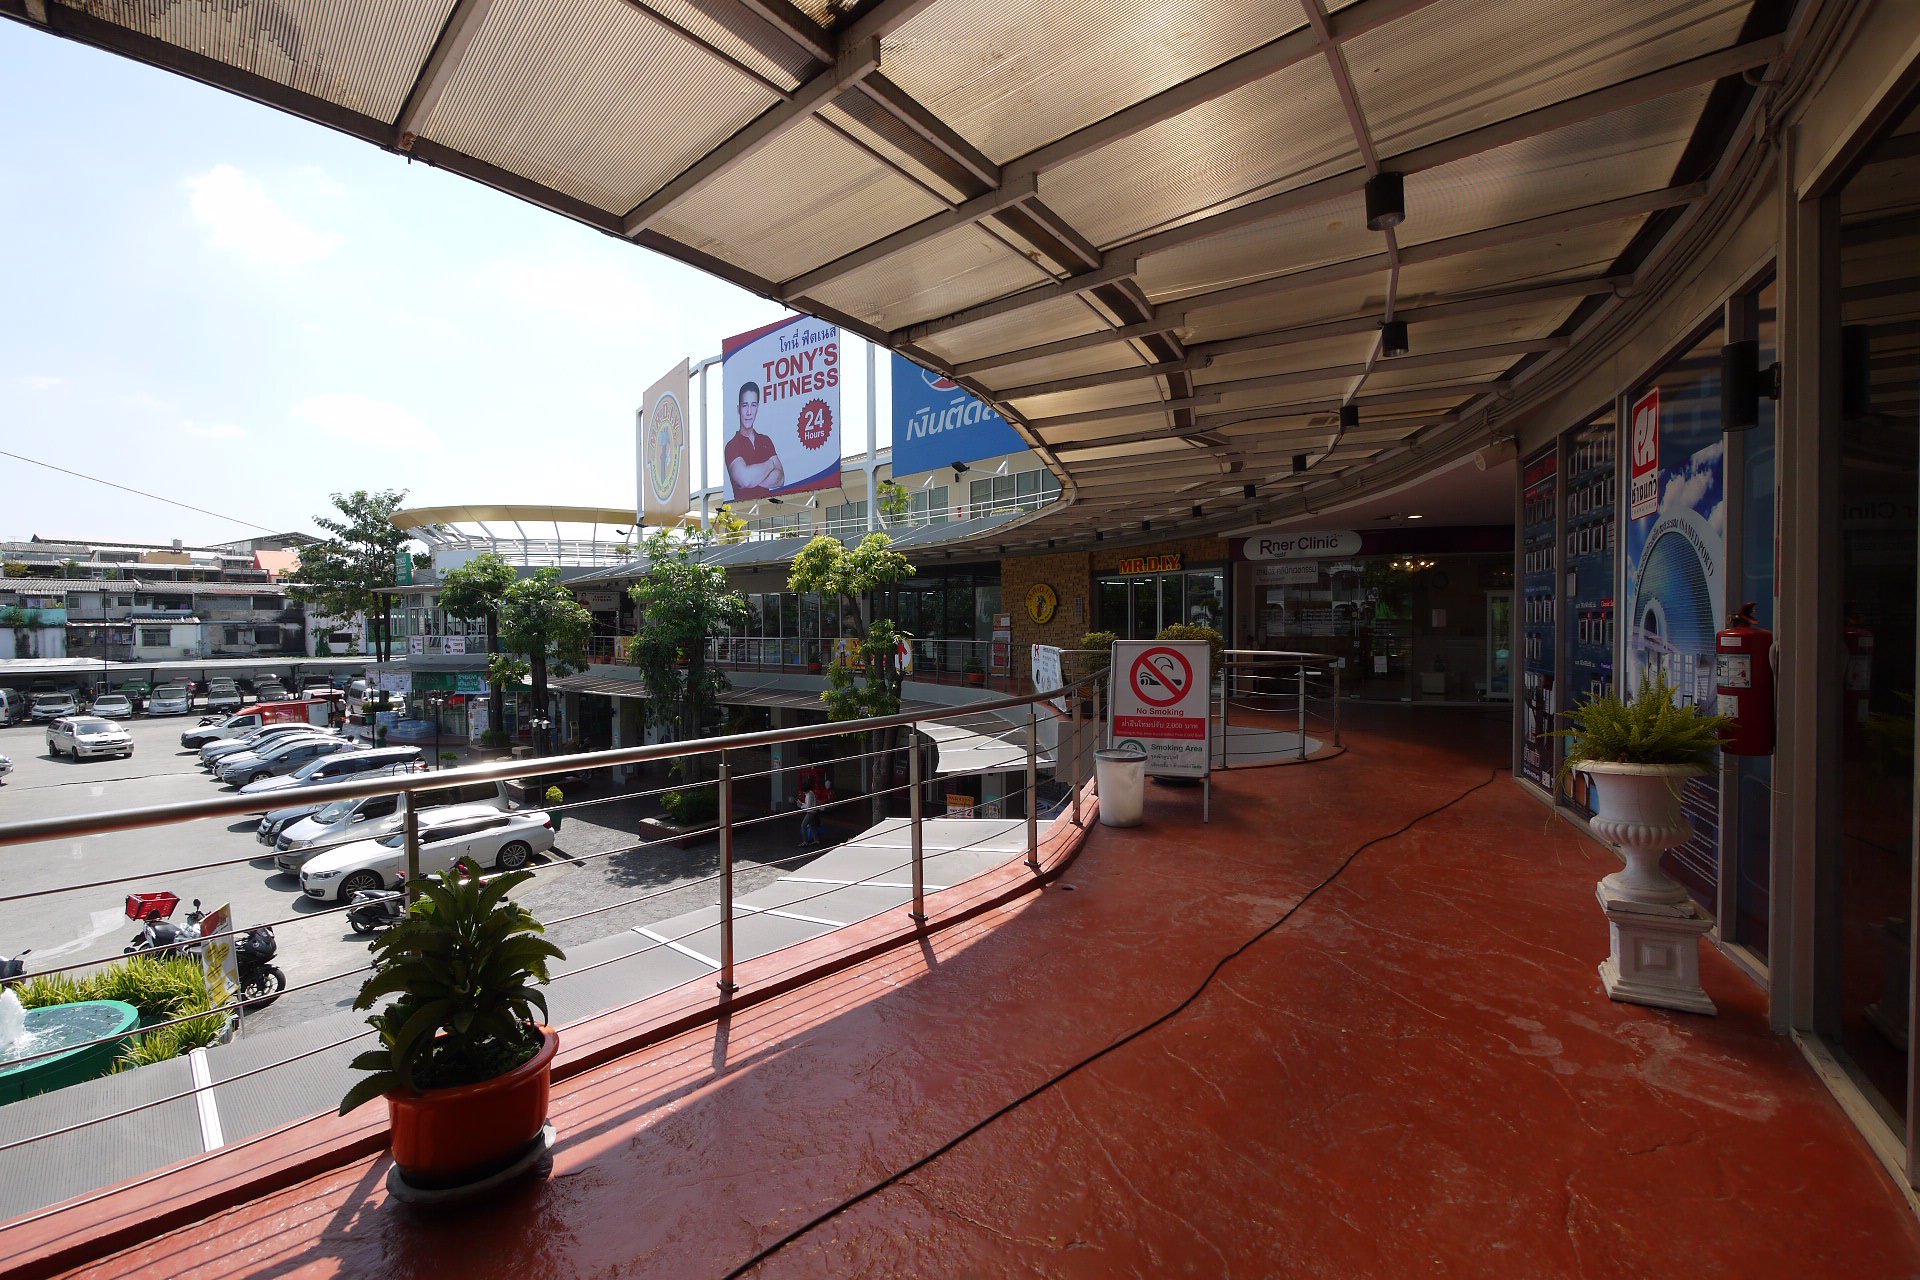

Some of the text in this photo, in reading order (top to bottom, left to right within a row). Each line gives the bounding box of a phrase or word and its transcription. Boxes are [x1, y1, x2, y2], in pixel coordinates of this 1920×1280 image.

[779, 329, 800, 352] โทนี่
[763, 343, 838, 383] TONY'S
[763, 367, 839, 404] FITNESS
[804, 408, 825, 431] 24
[804, 430, 825, 440] Hours
[1260, 536, 1339, 555] Rner Clinic
[1149, 708, 1184, 717] Smoking
[1151, 744, 1183, 752] Smoking
